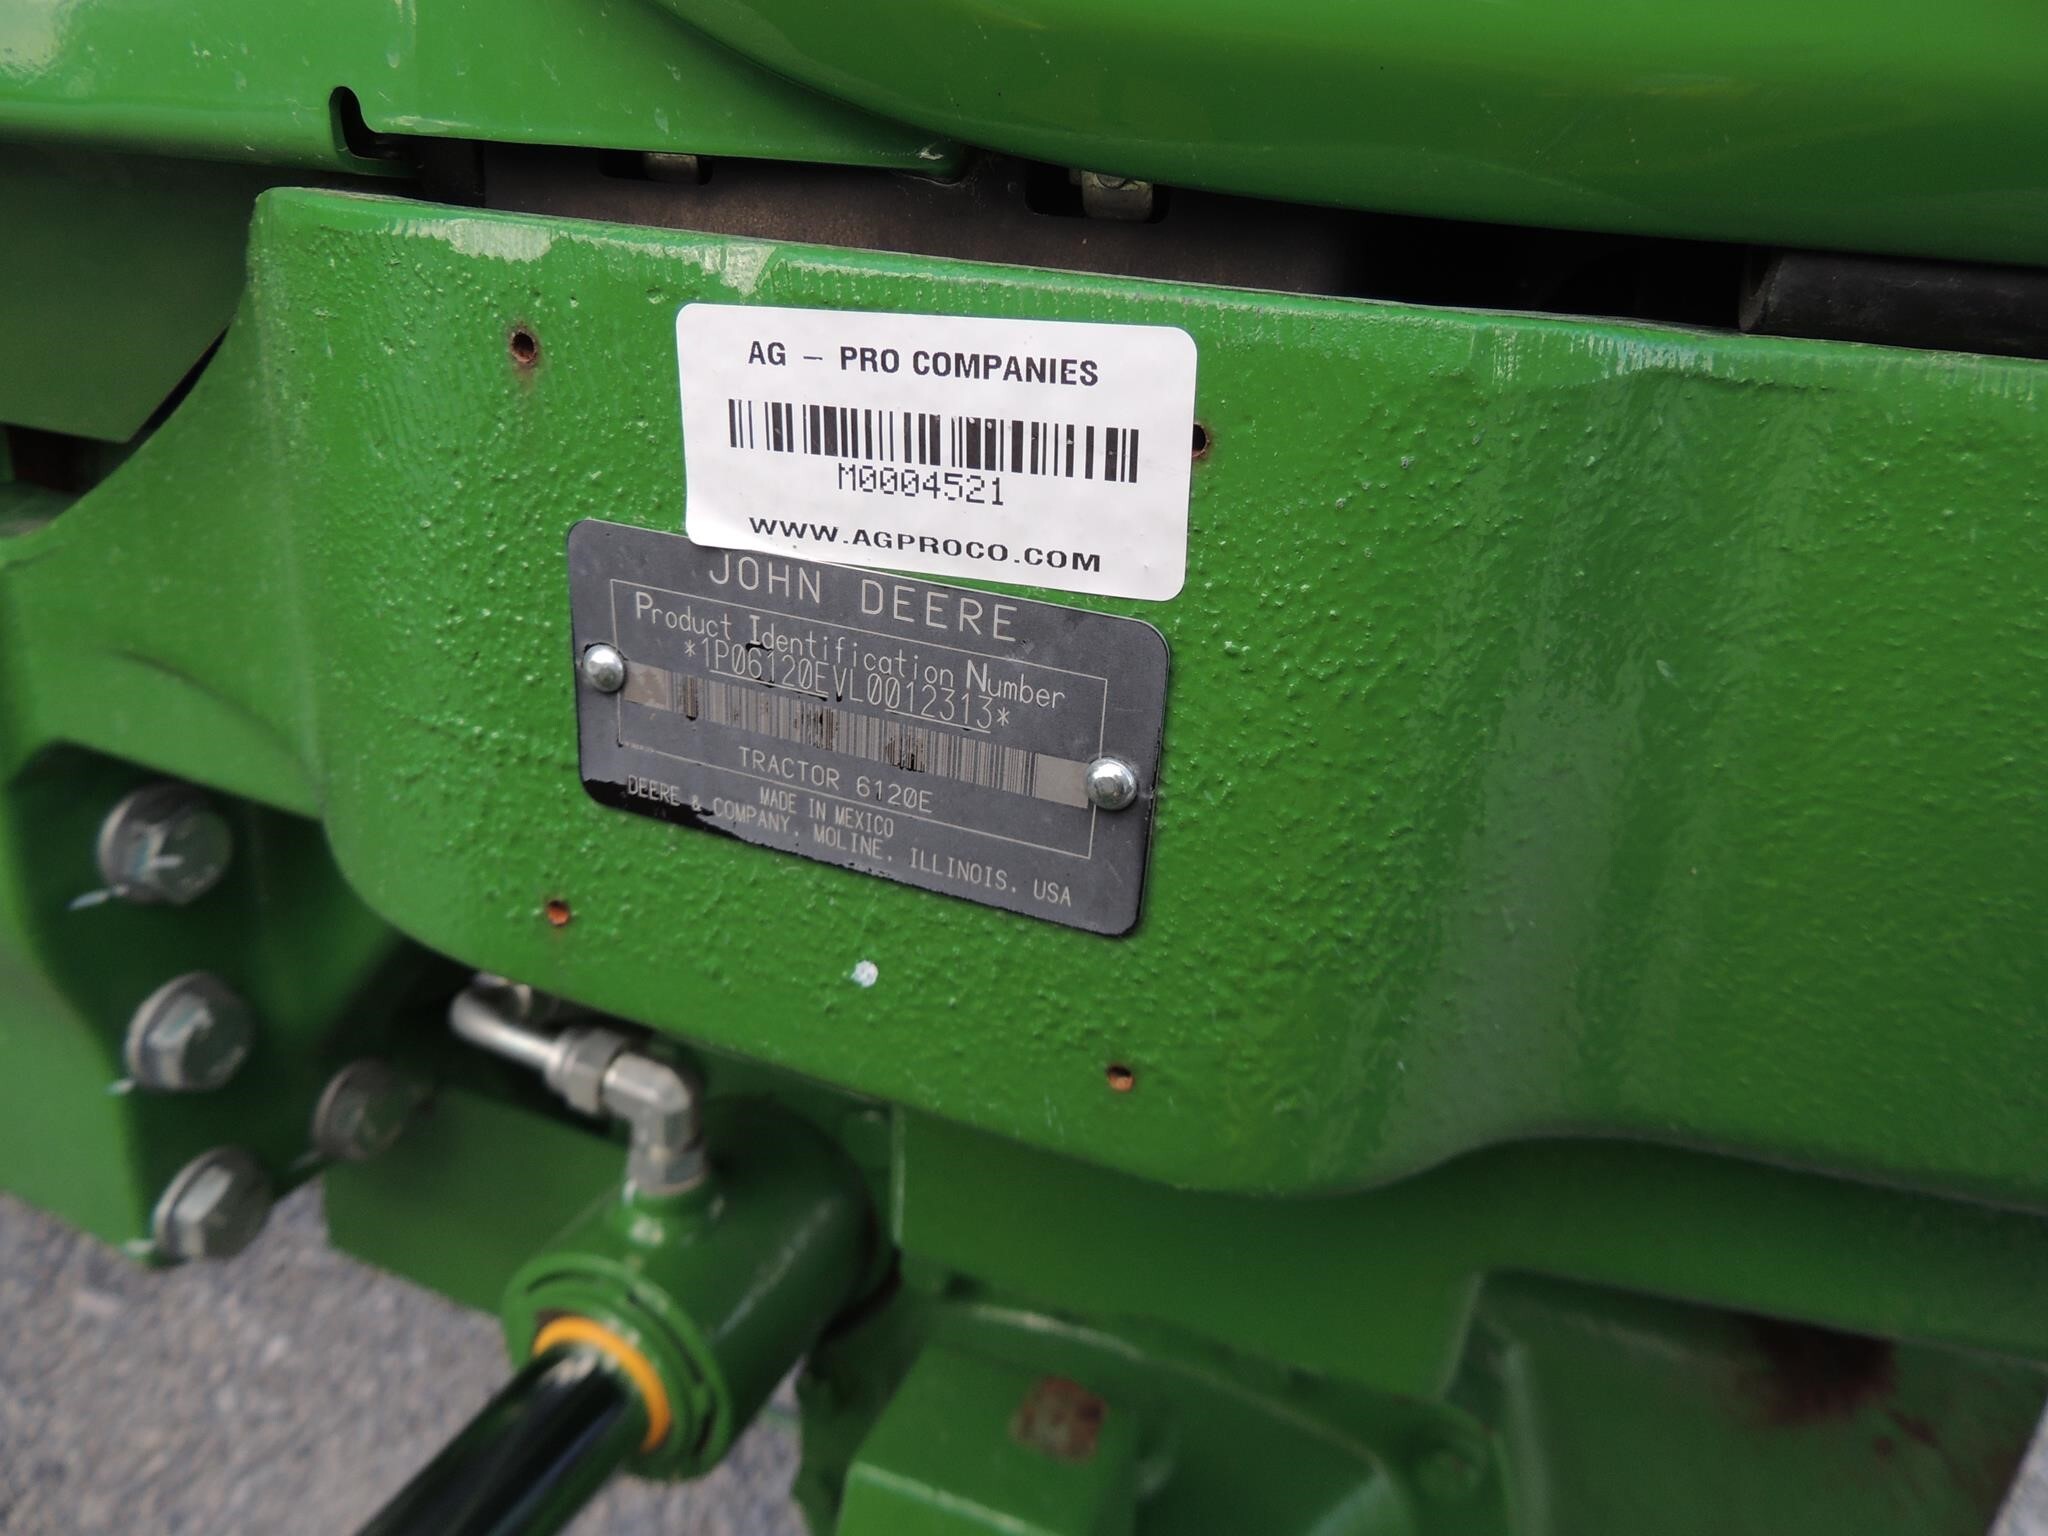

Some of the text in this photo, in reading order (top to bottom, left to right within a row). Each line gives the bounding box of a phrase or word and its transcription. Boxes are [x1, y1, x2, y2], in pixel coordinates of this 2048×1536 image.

[748, 340, 787, 367] AG
[840, 345, 900, 374] PRO
[912, 350, 1099, 387] COMPANIES
[838, 462, 1005, 506] M0004521
[749, 517, 1101, 573] WWW.AGPROCO.COM
[709, 553, 1018, 642] JOHN DEERE
[635, 591, 1066, 709] Product Identification Number
[738, 745, 934, 814] TRACTOR 6120E
[627, 774, 681, 807] DEERE
[691, 795, 702, 812] &
[1033, 878, 1072, 908] USA
[759, 786, 894, 839] MADE IN MEXICO
